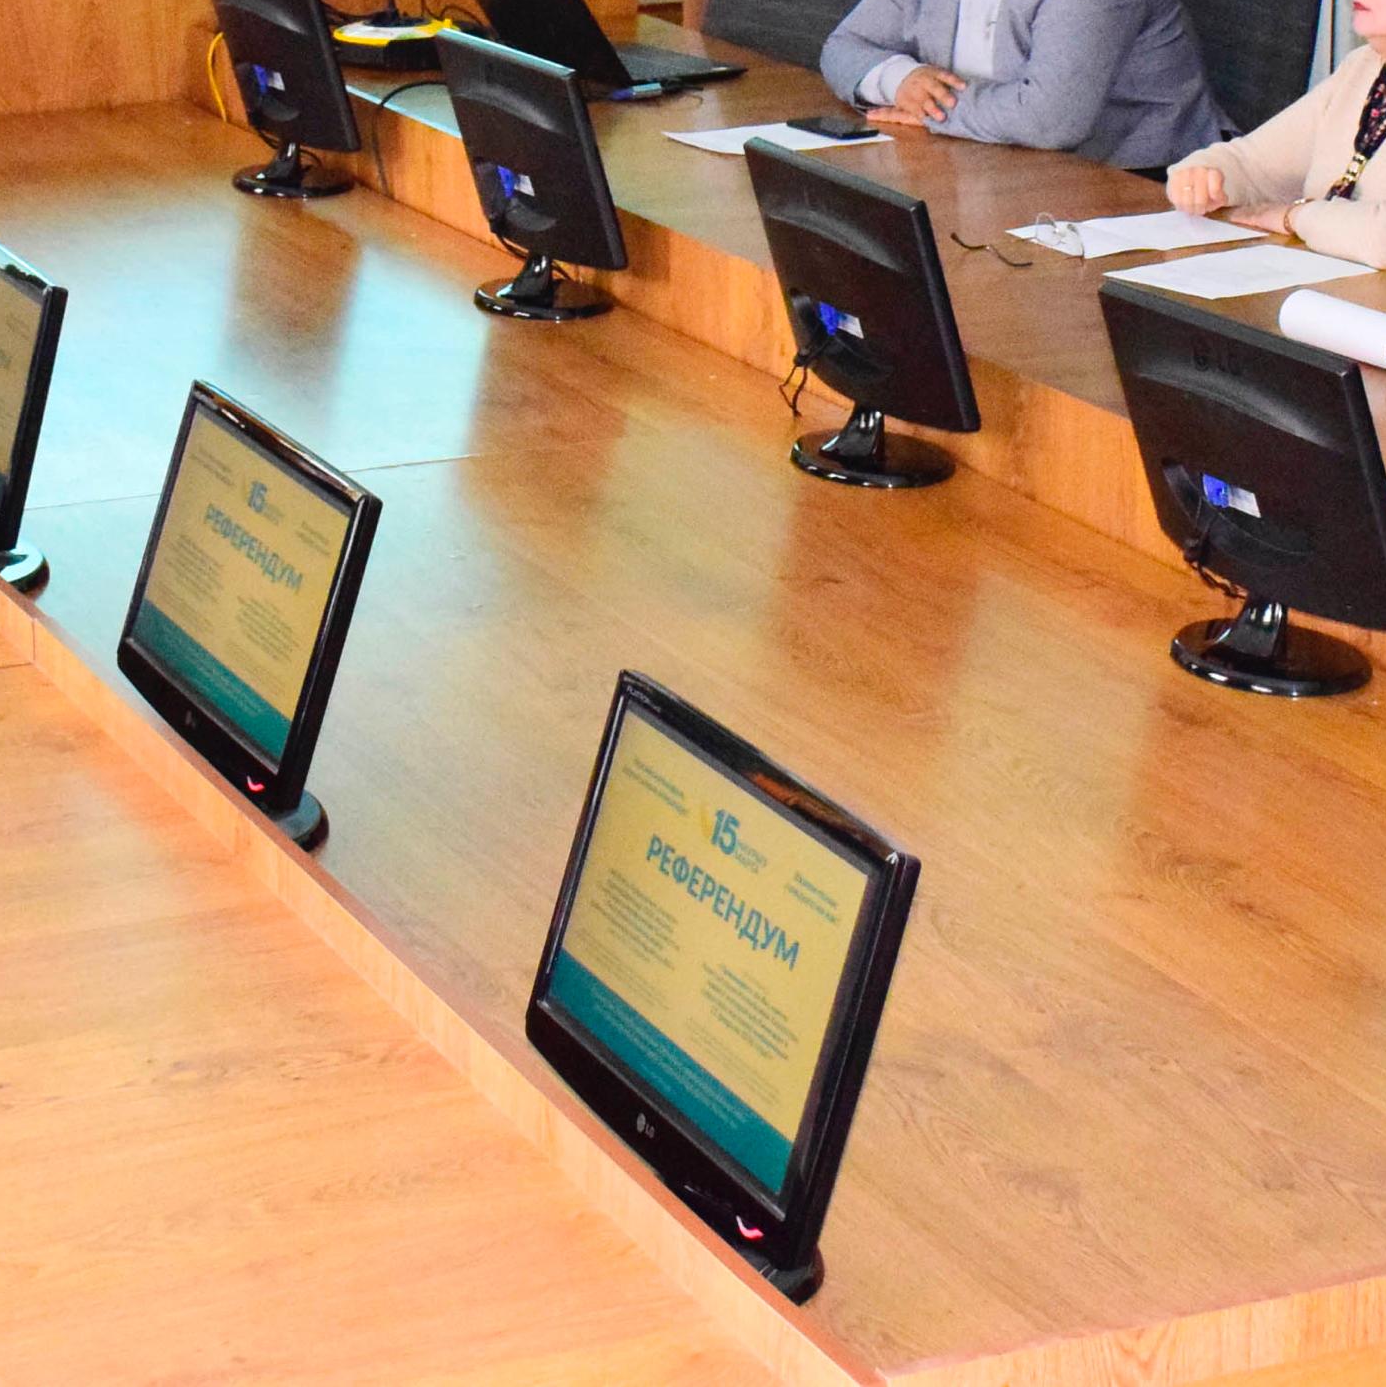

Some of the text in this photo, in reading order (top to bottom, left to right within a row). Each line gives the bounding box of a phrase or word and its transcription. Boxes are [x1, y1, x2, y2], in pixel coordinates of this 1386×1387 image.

[203, 502, 303, 595] РЕФЕРЕНДУМ
[711, 808, 740, 855] 15
[645, 833, 800, 971] РЕФЕРЕНДУМ
